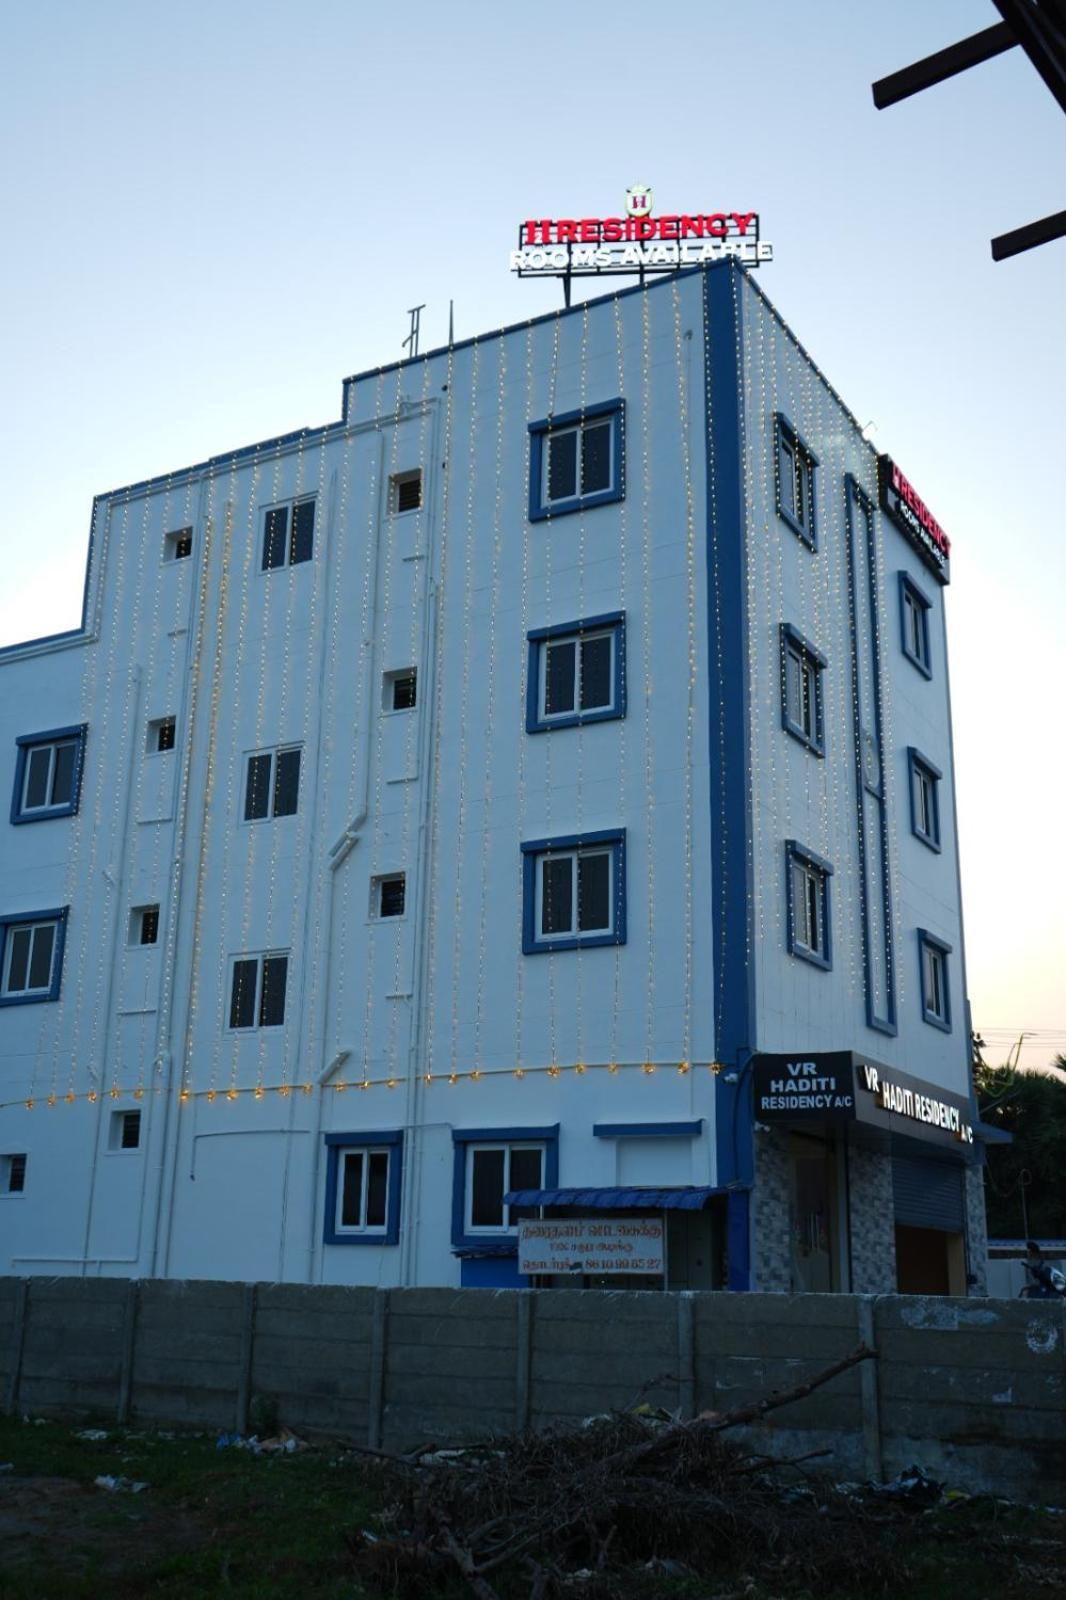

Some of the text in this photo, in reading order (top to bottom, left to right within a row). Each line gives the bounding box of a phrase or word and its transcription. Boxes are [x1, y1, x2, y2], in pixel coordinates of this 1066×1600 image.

[510, 240, 773, 270] ROOMS AVAILABLE
[787, 1062, 817, 1076] VR
[770, 1077, 836, 1093] HADITI
[761, 1094, 853, 1110] RESIDENCY A/C
[864, 1064, 974, 1145] VR HADITI RESIDENCY A/C
